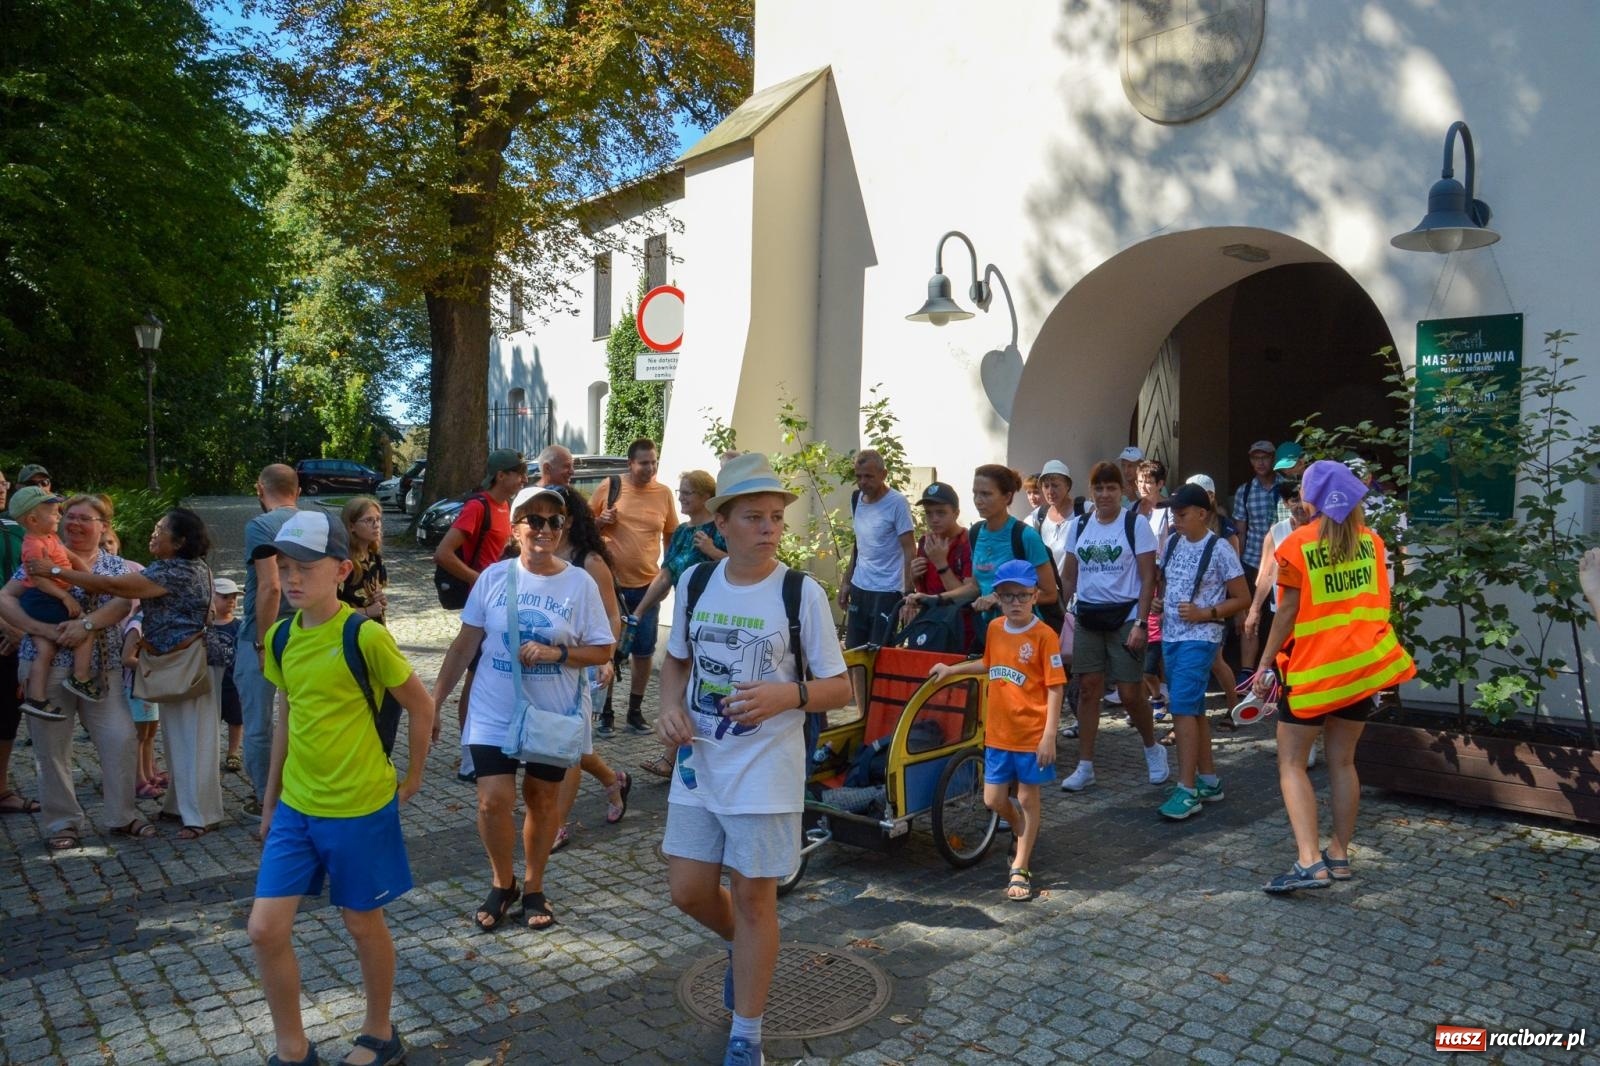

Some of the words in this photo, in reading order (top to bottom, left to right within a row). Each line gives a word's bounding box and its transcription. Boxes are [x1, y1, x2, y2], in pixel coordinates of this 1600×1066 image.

[1422, 351, 1515, 366] MASZYNOWNIA
[1332, 494, 1338, 503] 5
[712, 612, 729, 626] THE
[730, 614, 766, 630] FUTURE
[494, 660, 512, 672] NEW
